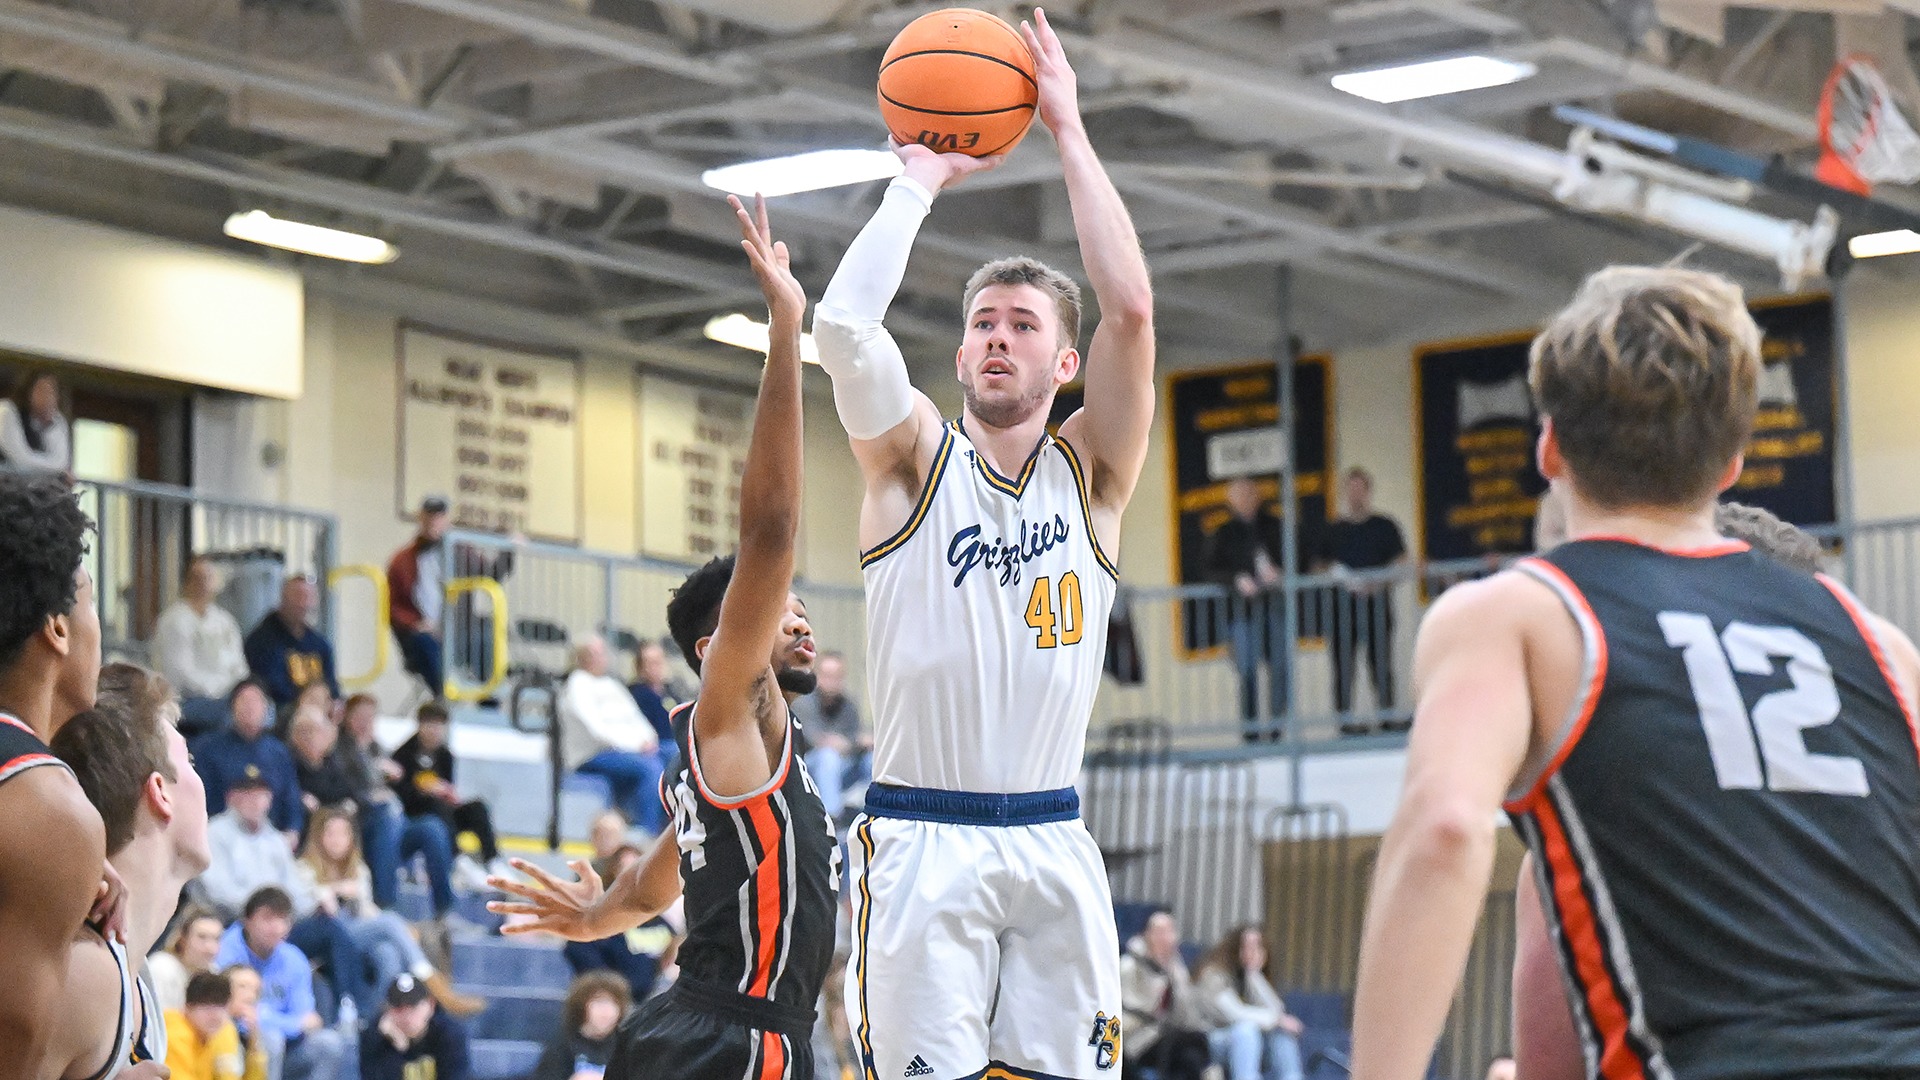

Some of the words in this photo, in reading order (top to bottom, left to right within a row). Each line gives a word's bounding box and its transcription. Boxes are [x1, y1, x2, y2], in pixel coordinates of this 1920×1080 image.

[917, 129, 980, 149] EVO
[947, 513, 1070, 588] Grizzlies
[1024, 570, 1084, 649] 40
[1656, 610, 1871, 798] 12
[904, 1066, 934, 1078] adidas
